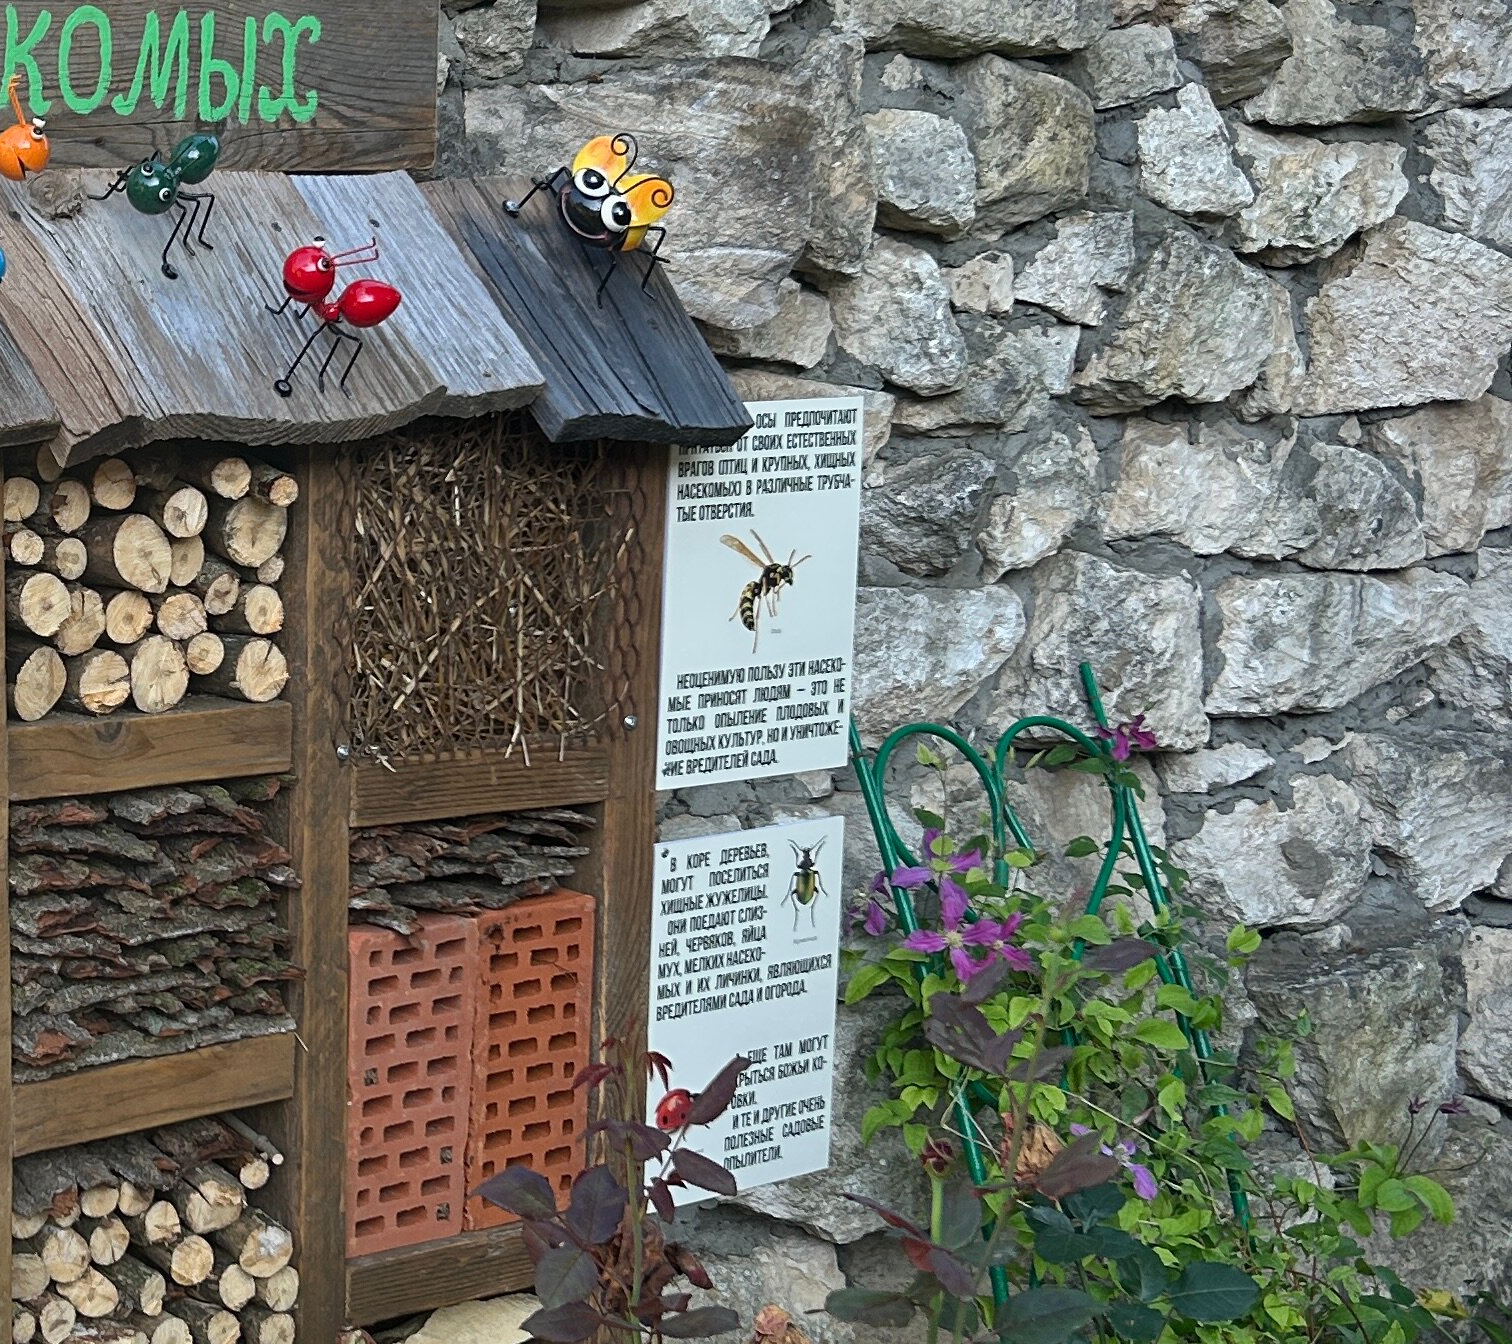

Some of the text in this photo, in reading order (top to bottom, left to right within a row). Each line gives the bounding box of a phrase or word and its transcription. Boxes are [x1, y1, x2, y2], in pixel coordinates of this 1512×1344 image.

[756, 409, 857, 429] ОСЫ ПРЕДПОЧИТАЮТ
[752, 434, 782, 450] СВОИХ
[787, 430, 856, 449] ЕСТЕСТВЕННЫХ
[678, 452, 855, 477] ВРАГОВ КРУПНЫХ, ХИЩНЫХ
[756, 476, 813, 494] РАЗЛИЧНЫЕ
[818, 474, 854, 490] ТРУБЧА-
[677, 502, 754, 522] ТЫЕ ОТВЕРСТИЯ.
[677, 657, 846, 689] НЕОЦЕНИМУЮ ПОЛЬЗУ ЭТИ НАСЕКО-
[667, 678, 845, 712] МЫЕ ПРИНОСЯТ ЛЮДЯМ ЭТО НЕ
[667, 701, 828, 734] ТОЛЬКО ОПЫЛЕНИЕ ПЛОДОВЫХ
[666, 733, 715, 755] ОВОЩНЫХ
[767, 728, 779, 743] НО
[790, 720, 843, 740] УНИЧТОЖЕ-
[686, 749, 778, 775] ВРЕДИТЕЛЕЙ САДА.
[687, 852, 710, 869] КОРЕ
[661, 863, 769, 895] МОГУТ ПОСЕЛИТЬСЯ
[660, 894, 704, 916] ХИЩНЫЕ
[668, 906, 767, 936] ОНИ ПОЕДАЮТ СЛИЗ-
[742, 925, 766, 943] ЯЙЦА
[657, 954, 832, 1000] МЫХ ИХ ЛИЧИНКИ, ЯВЛЯЮЩИХСЯ
[658, 947, 766, 979] МУХ, МЕЛКИХ НАСЕКО-
[657, 979, 807, 1021] ВРЕДИТЕЛЯМИ САДА ОГОРОДА.
[774, 1042, 792, 1059] ТАМ
[799, 1035, 828, 1054] МОГУТ
[778, 1056, 827, 1079] БОЖЬИ КО-
[742, 1095, 825, 1127] ТЕ ДРУГИЕ ОЧЕНЬ
[724, 1115, 825, 1152] ПОЛЕЗНЫЕ САДОВЫЕ
